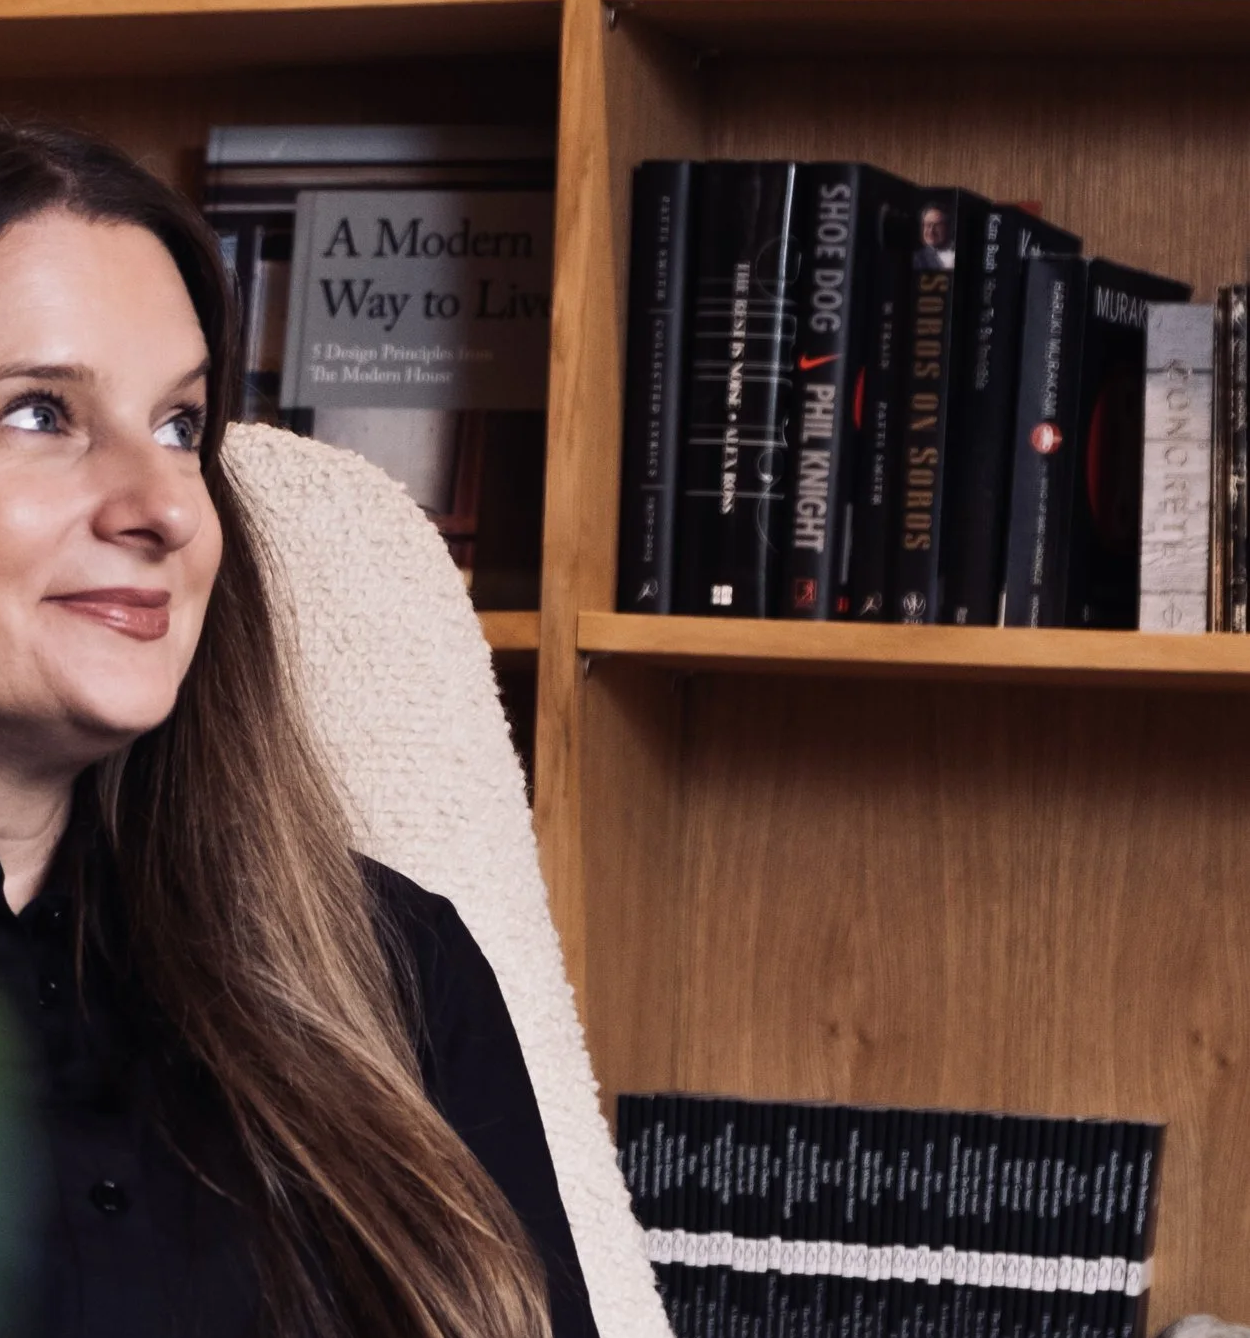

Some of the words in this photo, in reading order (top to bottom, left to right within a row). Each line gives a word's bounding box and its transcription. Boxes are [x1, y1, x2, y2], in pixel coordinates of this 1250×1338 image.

[322, 216, 362, 259] A
[370, 216, 534, 260] Modern
[658, 195, 671, 243] PATTI
[816, 183, 851, 259] SHOE
[986, 214, 1003, 241] Kate
[656, 249, 670, 302] SMITH
[735, 262, 752, 294] THE
[984, 243, 1000, 273] Bush
[319, 277, 412, 333] Way
[422, 287, 462, 320] to
[475, 276, 551, 320] Live
[733, 299, 749, 338] REST
[810, 268, 846, 333] DOG
[1049, 281, 1065, 335] HARUKI
[731, 342, 747, 359] IS
[912, 273, 950, 380] SOROS
[310, 363, 338, 382] The
[342, 364, 402, 382] Modern
[403, 364, 453, 382] House
[312, 344, 322, 360] 5
[325, 343, 378, 365] Design
[380, 343, 455, 364] Principles
[459, 344, 494, 361] from
[651, 319, 666, 414] COLLECTED
[1041, 338, 1062, 418] MURAKAMI
[727, 361, 745, 408] NOISE
[801, 383, 837, 444] PHIL
[875, 401, 889, 448] PATTI
[910, 391, 942, 432] ON
[648, 420, 663, 478] LYRICS
[1161, 359, 1194, 559] CONCRETE
[720, 472, 738, 515] ROSS
[793, 449, 833, 552] KNIGHT
[870, 455, 886, 505] SMITH
[902, 446, 940, 551] SOROS
[1032, 538, 1045, 585] CHRONICLE
